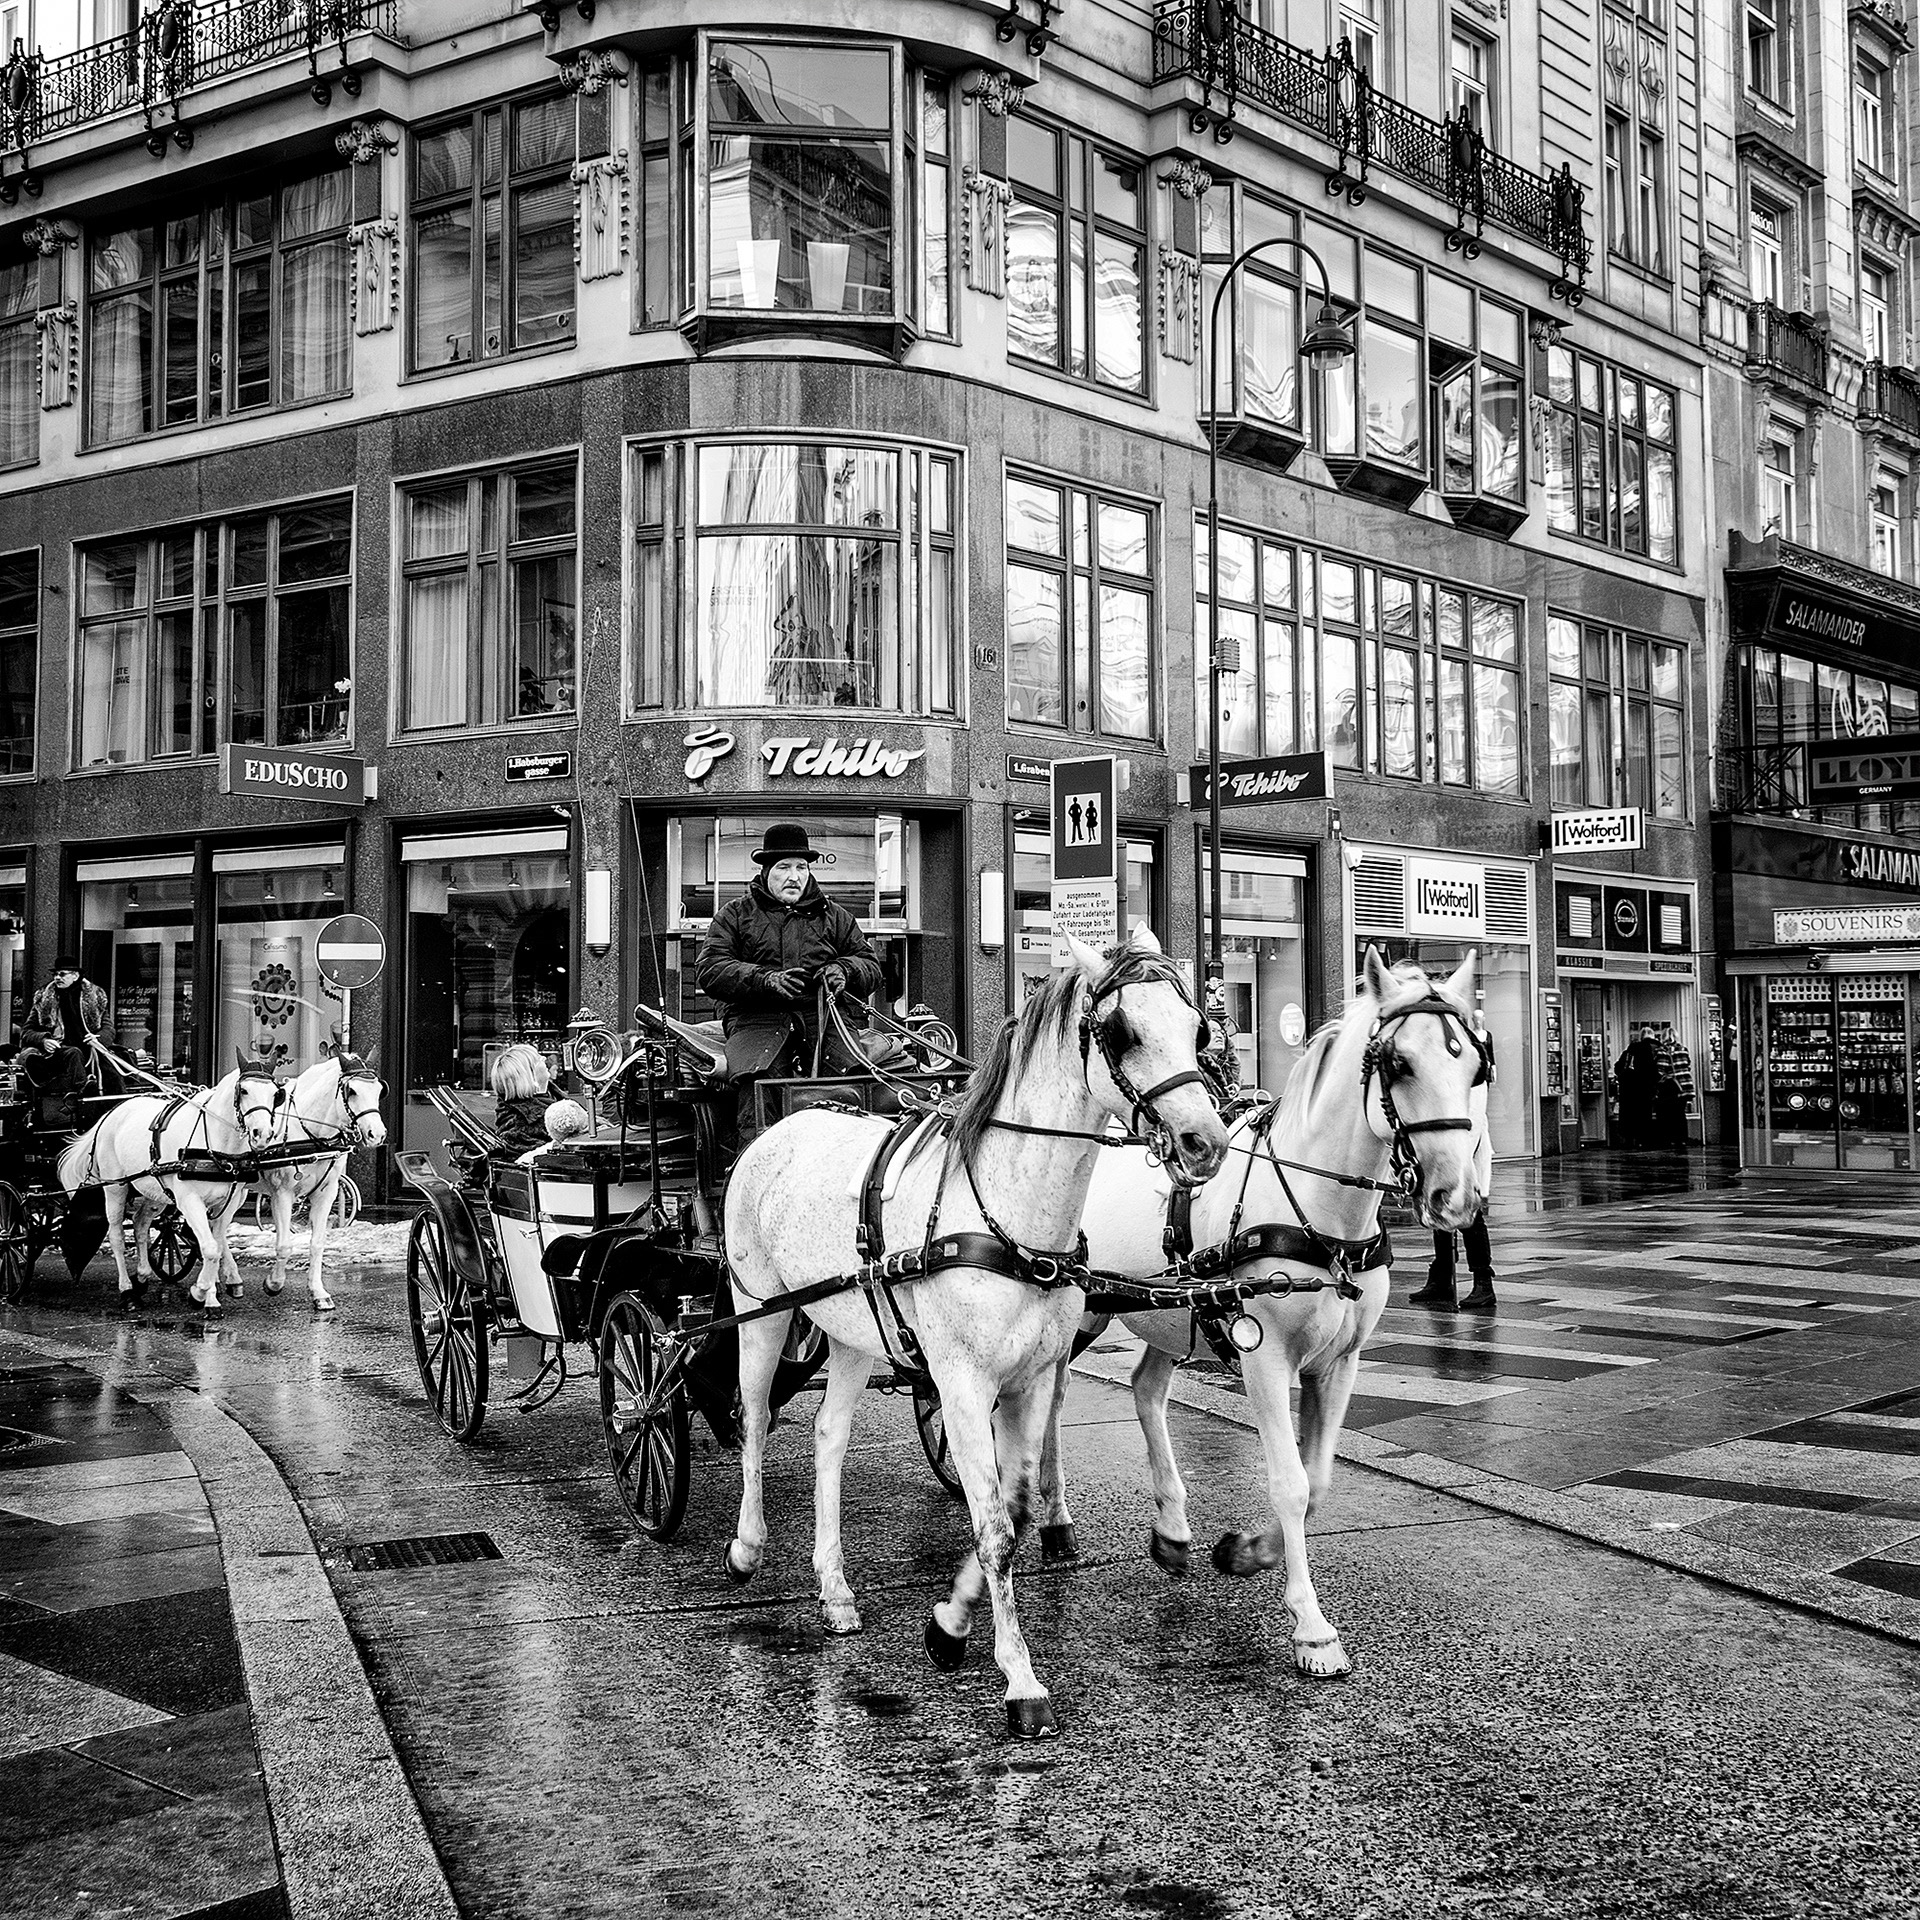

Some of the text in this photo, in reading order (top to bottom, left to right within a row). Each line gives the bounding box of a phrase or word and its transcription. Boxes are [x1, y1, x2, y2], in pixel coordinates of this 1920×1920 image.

[1786, 600, 1866, 646] SALAMANDER
[982, 648, 995, 663] 16
[760, 737, 926, 777] Tchibo
[524, 767, 550, 779] gasse
[1230, 769, 1310, 797] Tchibo
[1859, 786, 1893, 795] GERMANY
[1568, 822, 1621, 839] Wolford
[1067, 892, 1101, 900] ausgenommen
[1428, 888, 1469, 909] Wolford
[1053, 911, 1071, 919] Zufahrt
[1094, 919, 1102, 927] bis
[1801, 914, 1903, 931] SOUVENIRS
[1078, 929, 1116, 938] Gesamtgewicht
[1565, 956, 1593, 967] KLASSIK
